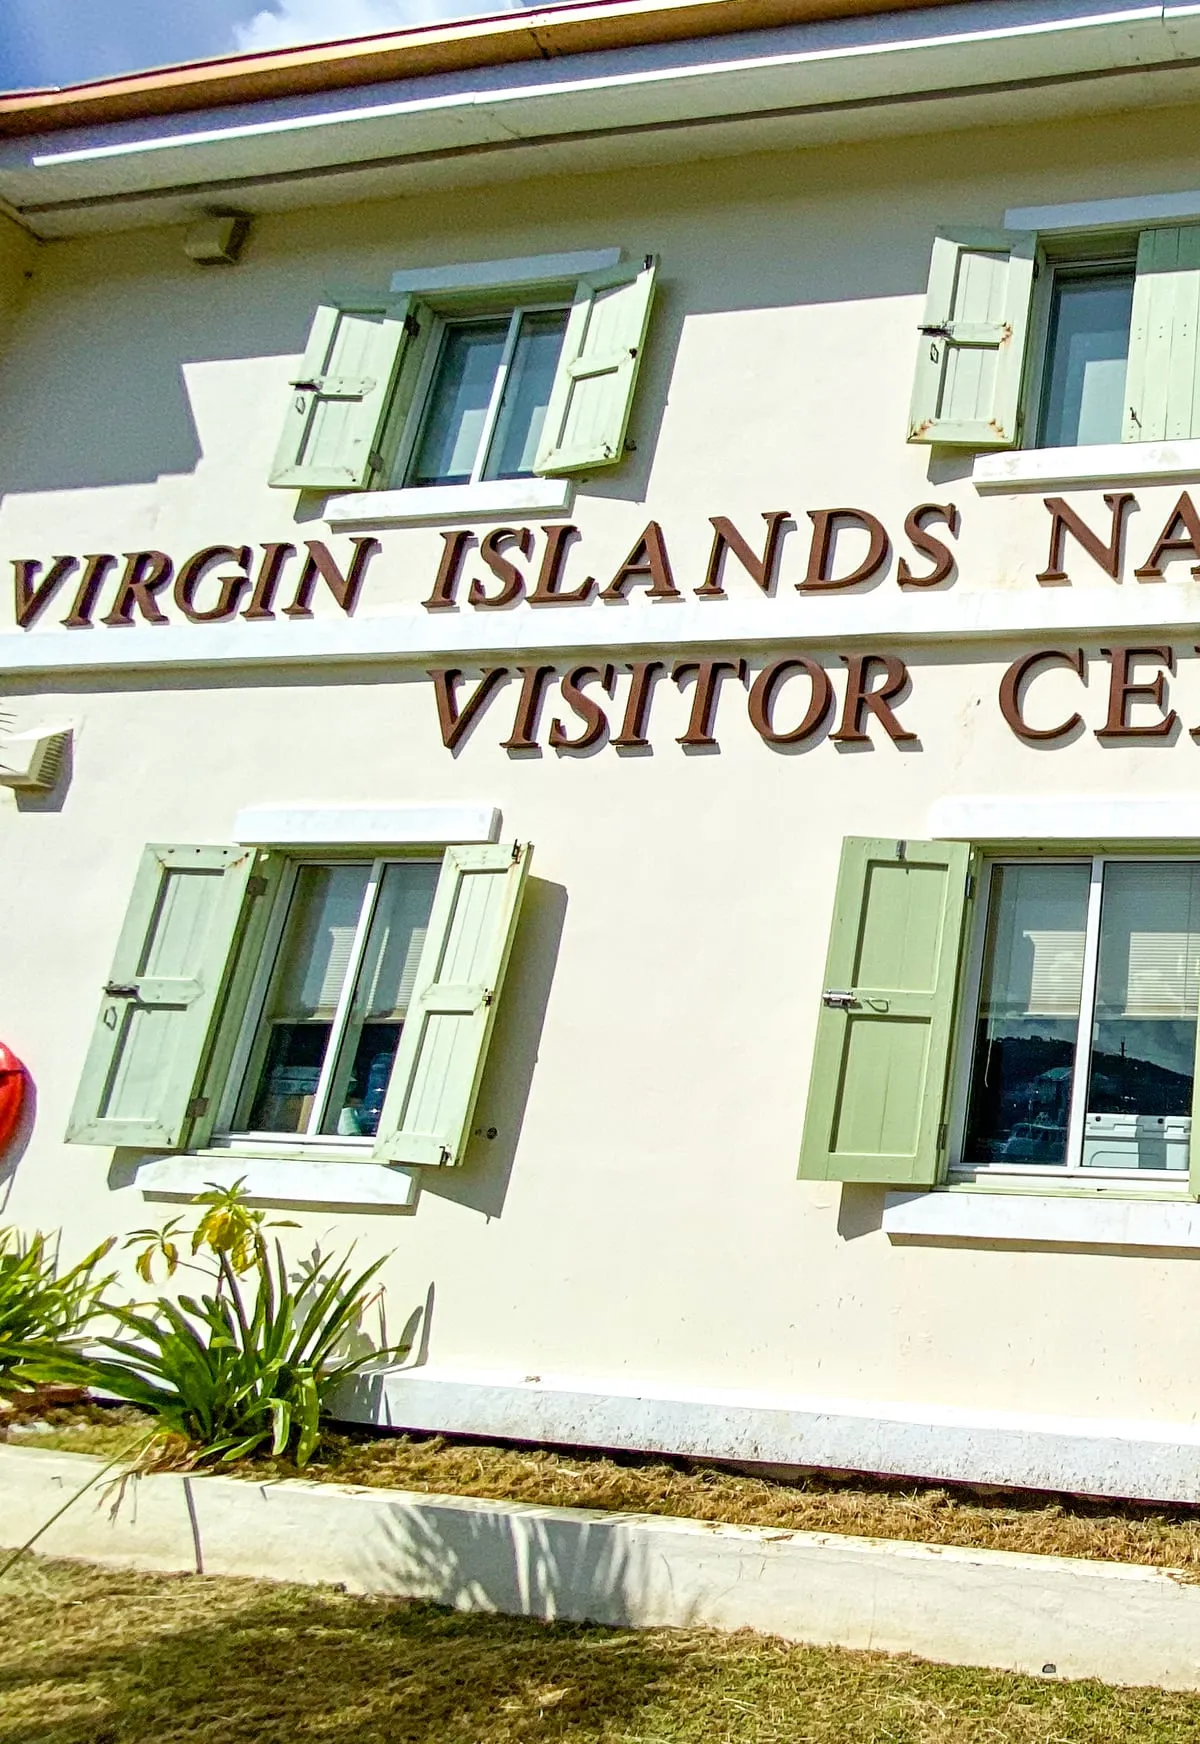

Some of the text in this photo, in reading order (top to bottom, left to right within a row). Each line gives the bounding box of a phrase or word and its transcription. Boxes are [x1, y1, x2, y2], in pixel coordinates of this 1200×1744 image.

[10, 536, 380, 628] VIRGIN
[422, 501, 960, 607] ISLANDS
[427, 653, 917, 748] VISITOR
